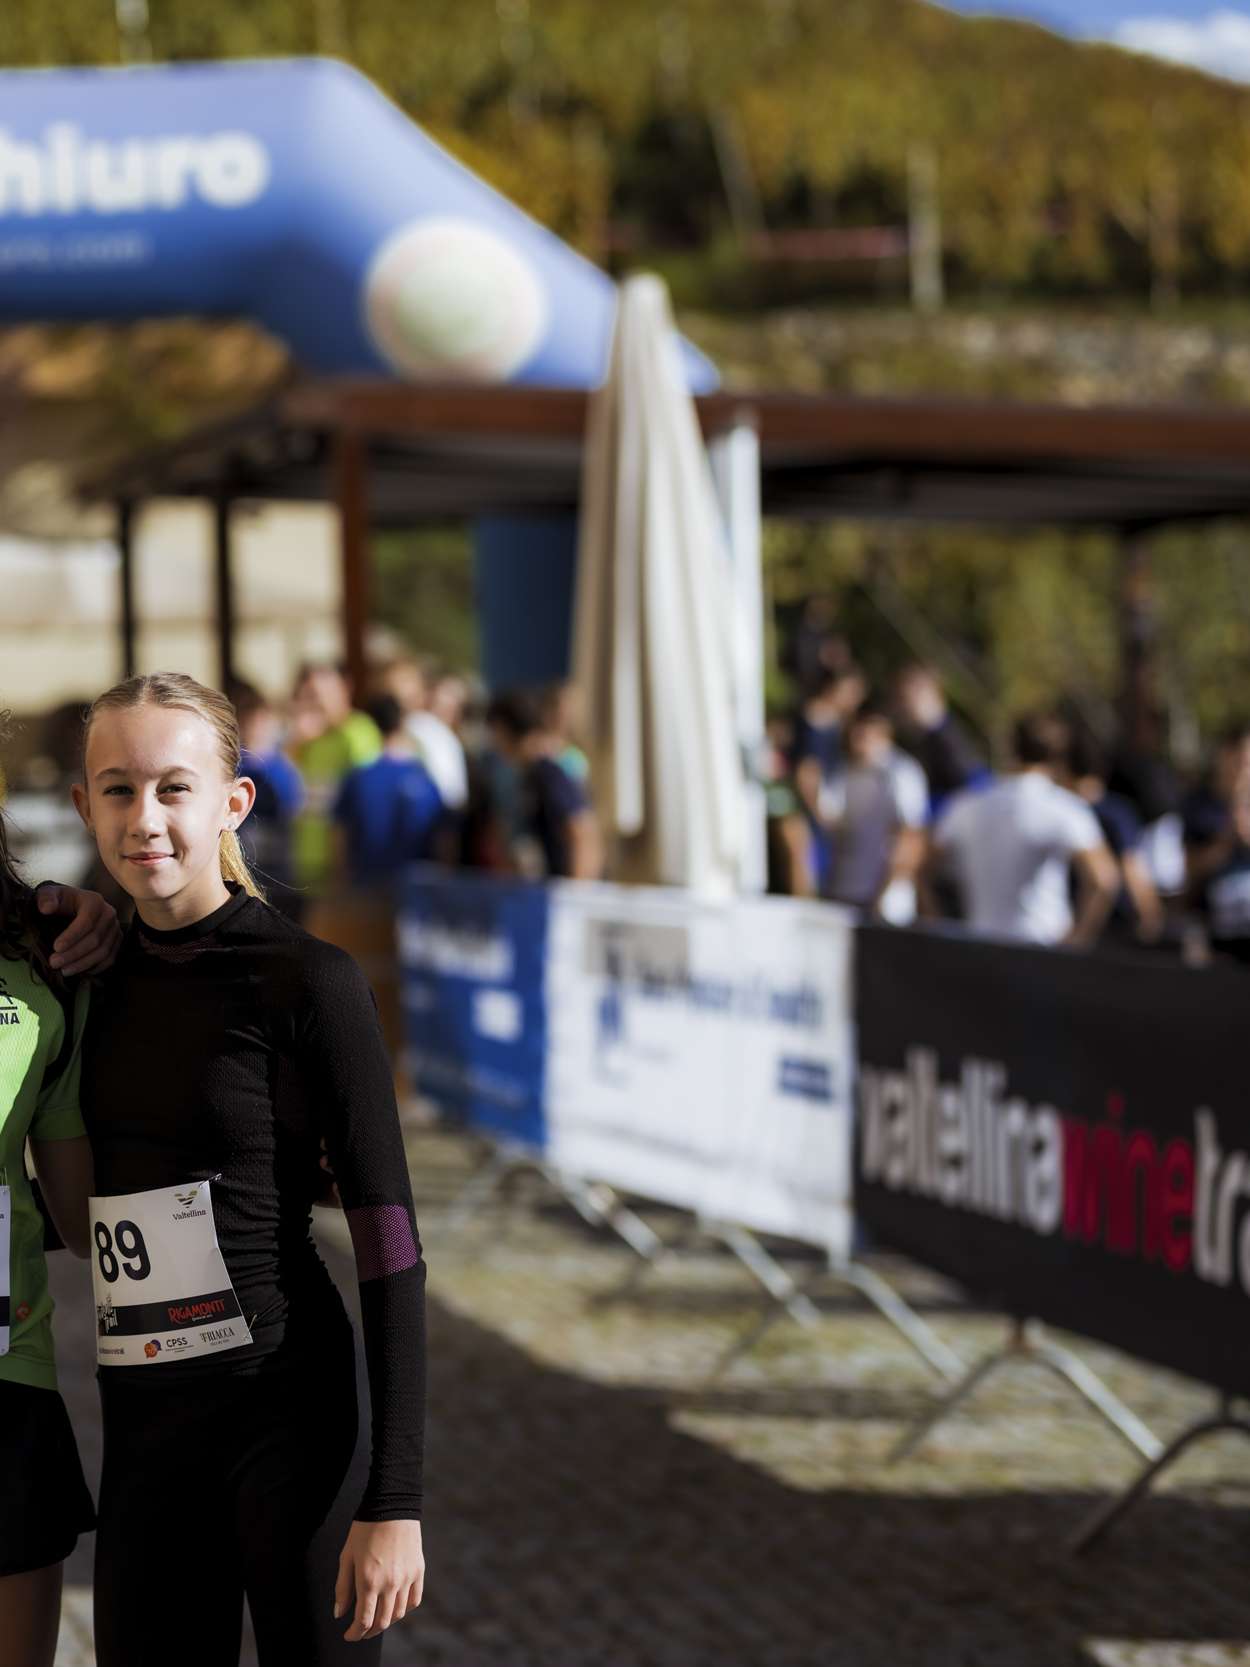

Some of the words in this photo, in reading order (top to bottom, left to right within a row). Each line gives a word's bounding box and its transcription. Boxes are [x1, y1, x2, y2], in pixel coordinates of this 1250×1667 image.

[172, 1208, 207, 1221] Valtellina
[94, 1220, 151, 1283] 89
[168, 1299, 225, 1325] RIGAMONTI
[166, 1337, 188, 1348] CPSS
[199, 1327, 235, 1343] TRIACCA
